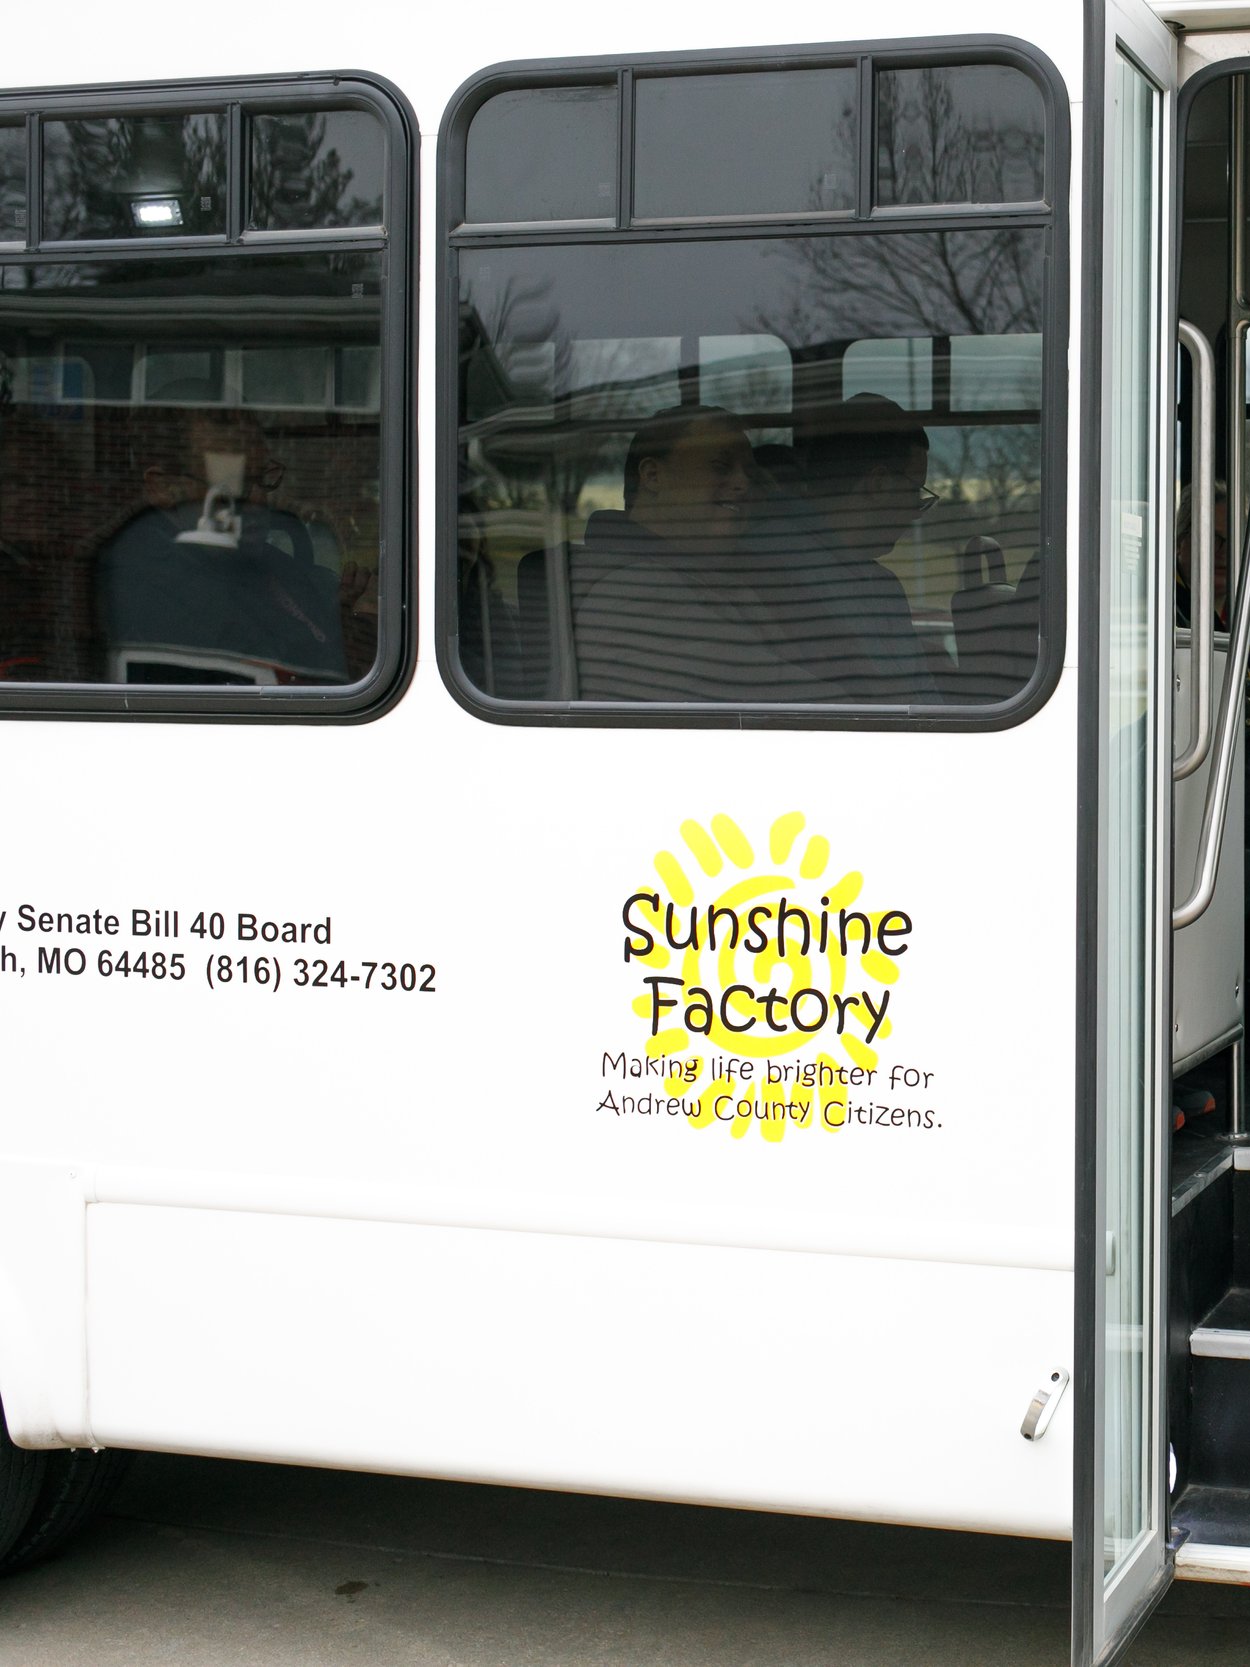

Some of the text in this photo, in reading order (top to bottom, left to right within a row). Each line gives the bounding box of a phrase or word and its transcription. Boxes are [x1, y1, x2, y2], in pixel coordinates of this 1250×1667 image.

[17, 904, 120, 936] Senate
[132, 908, 179, 938] Bill
[190, 911, 226, 940] 40
[237, 913, 332, 945] Board
[622, 893, 913, 963] Sunshine
[38, 946, 87, 976] MO
[97, 949, 187, 982] 64485
[206, 954, 281, 993] (816)
[293, 958, 436, 993] 324-7302
[643, 976, 890, 1045] Factory
[602, 1051, 935, 1091] Making life brighter for
[596, 1089, 943, 1129] Andrew County Citizens.
